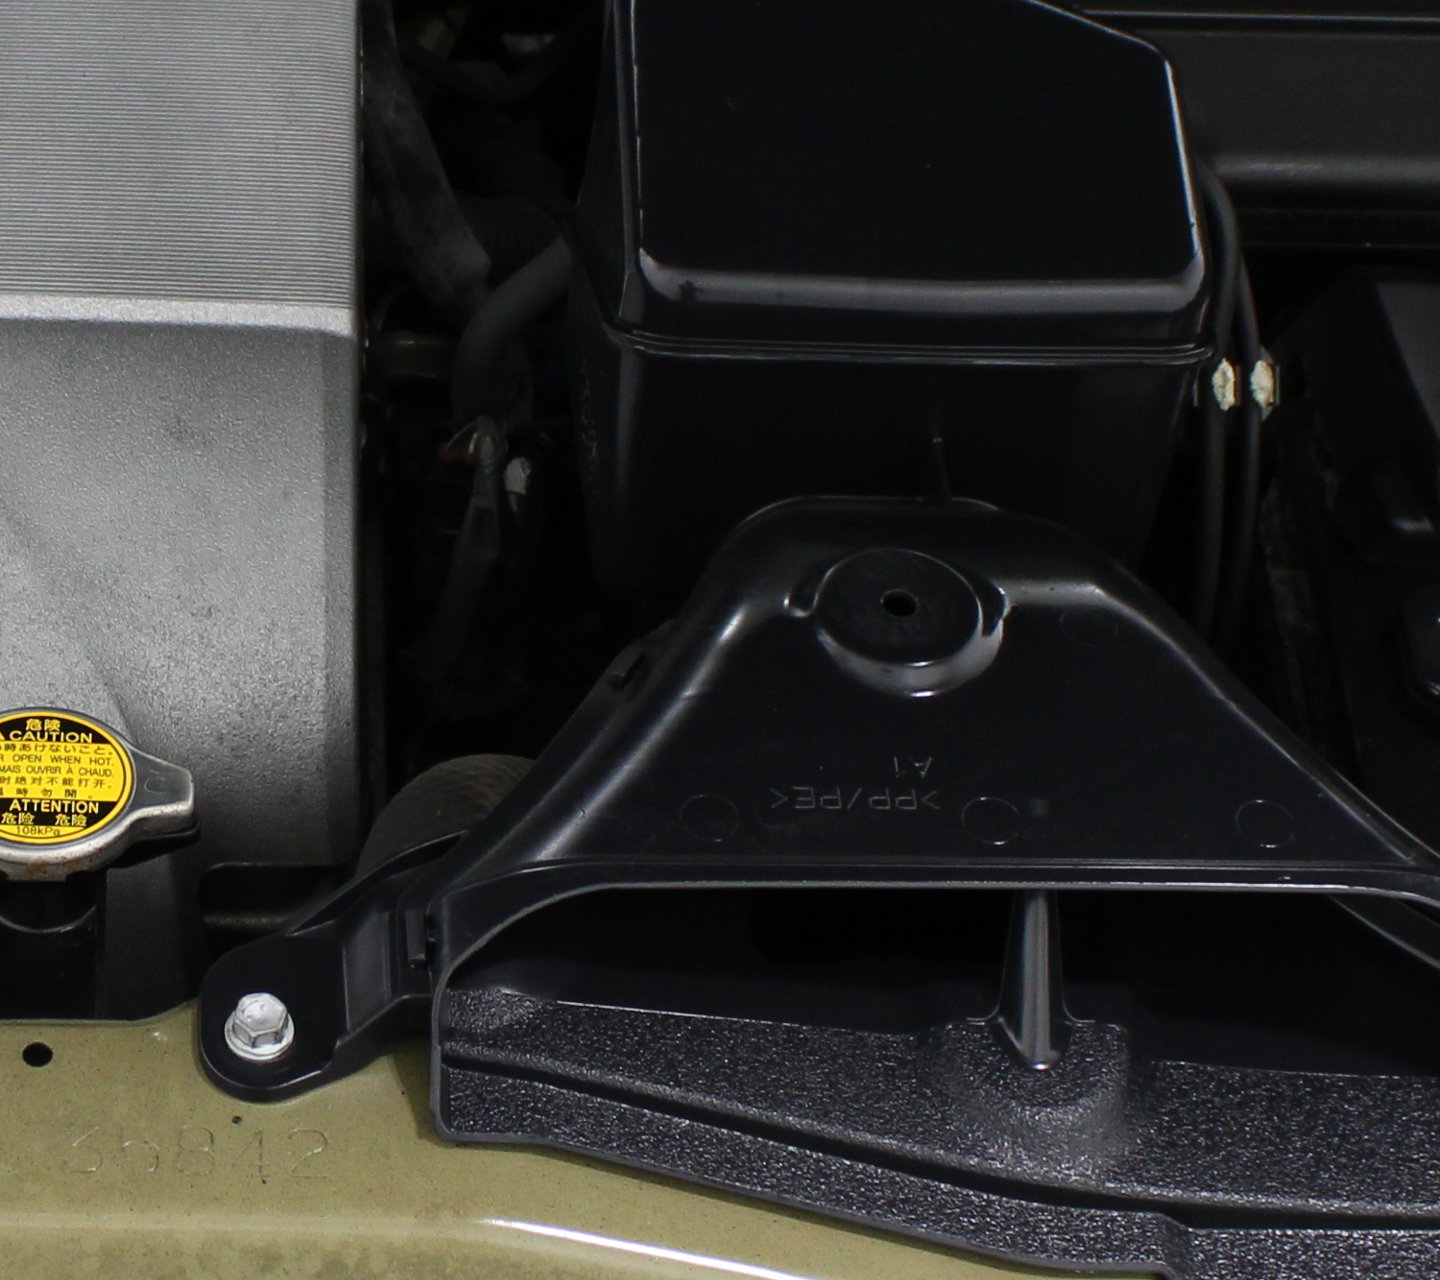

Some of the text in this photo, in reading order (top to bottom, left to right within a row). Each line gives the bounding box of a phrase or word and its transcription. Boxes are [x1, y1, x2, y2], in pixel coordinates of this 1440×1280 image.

[25, 718, 61, 732] 危険
[9, 730, 93, 744] CAUTION
[12, 754, 42, 763] OPEN
[50, 755, 81, 765] WHEN
[26, 766, 62, 775] OUVRIR
[66, 763, 74, 775] À
[9, 799, 100, 814] ATTENTION
[16, 825, 61, 836] 108kPa
